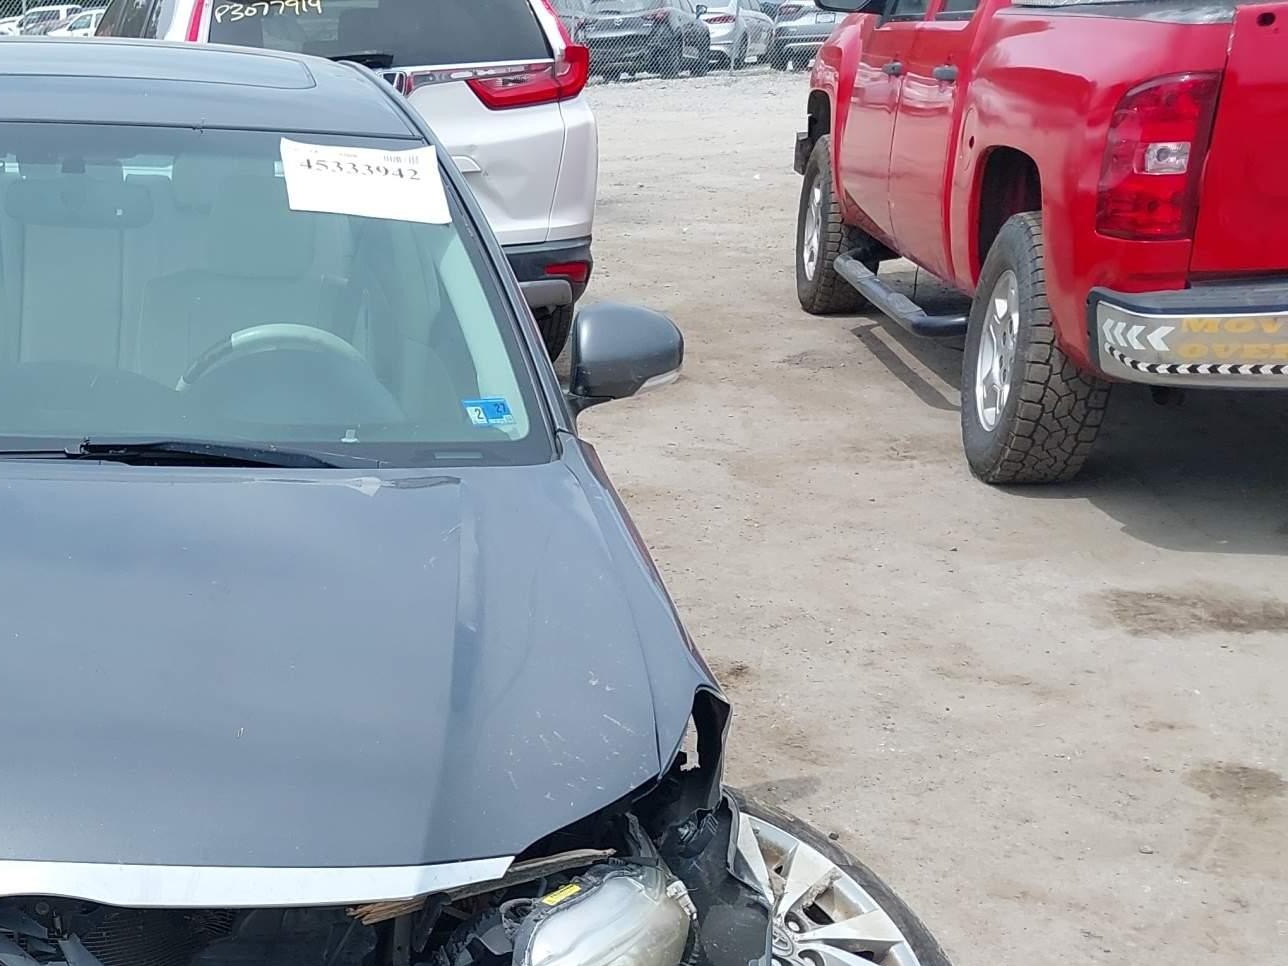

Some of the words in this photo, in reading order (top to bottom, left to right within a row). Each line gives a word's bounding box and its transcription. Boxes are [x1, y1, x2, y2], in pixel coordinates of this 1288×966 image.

[299, 158, 421, 181] 45333942
[1181, 318, 1284, 334] MOV
[474, 408, 484, 420] 2
